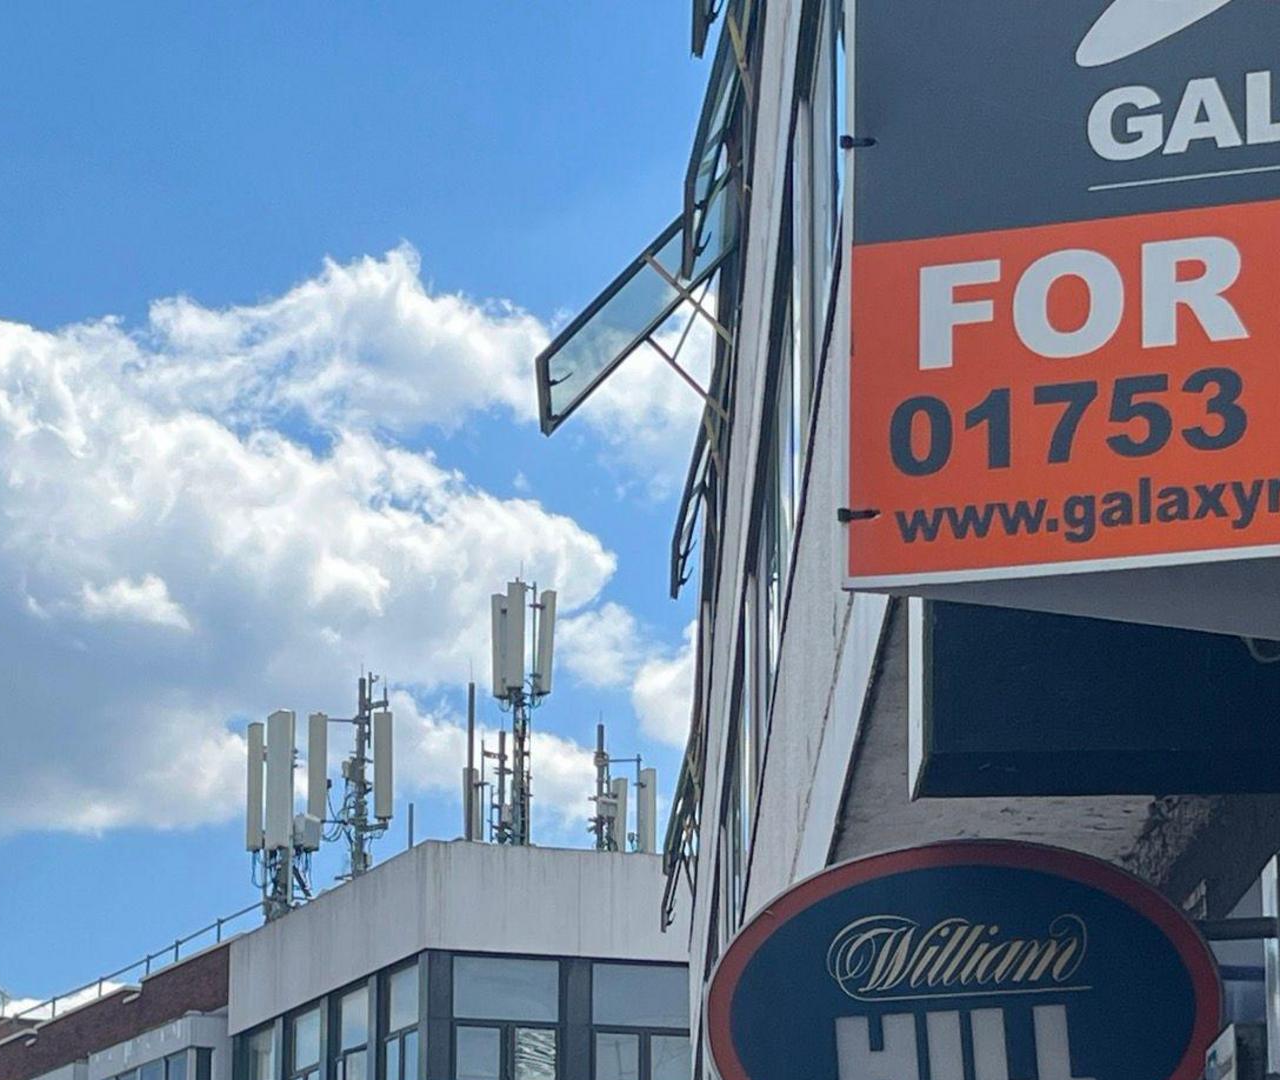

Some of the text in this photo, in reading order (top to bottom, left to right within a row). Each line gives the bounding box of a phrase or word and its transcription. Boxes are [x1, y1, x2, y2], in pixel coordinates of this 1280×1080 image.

[918, 236, 1250, 371] FOR
[887, 363, 1248, 477] 01753
[826, 914, 1094, 1001] William
